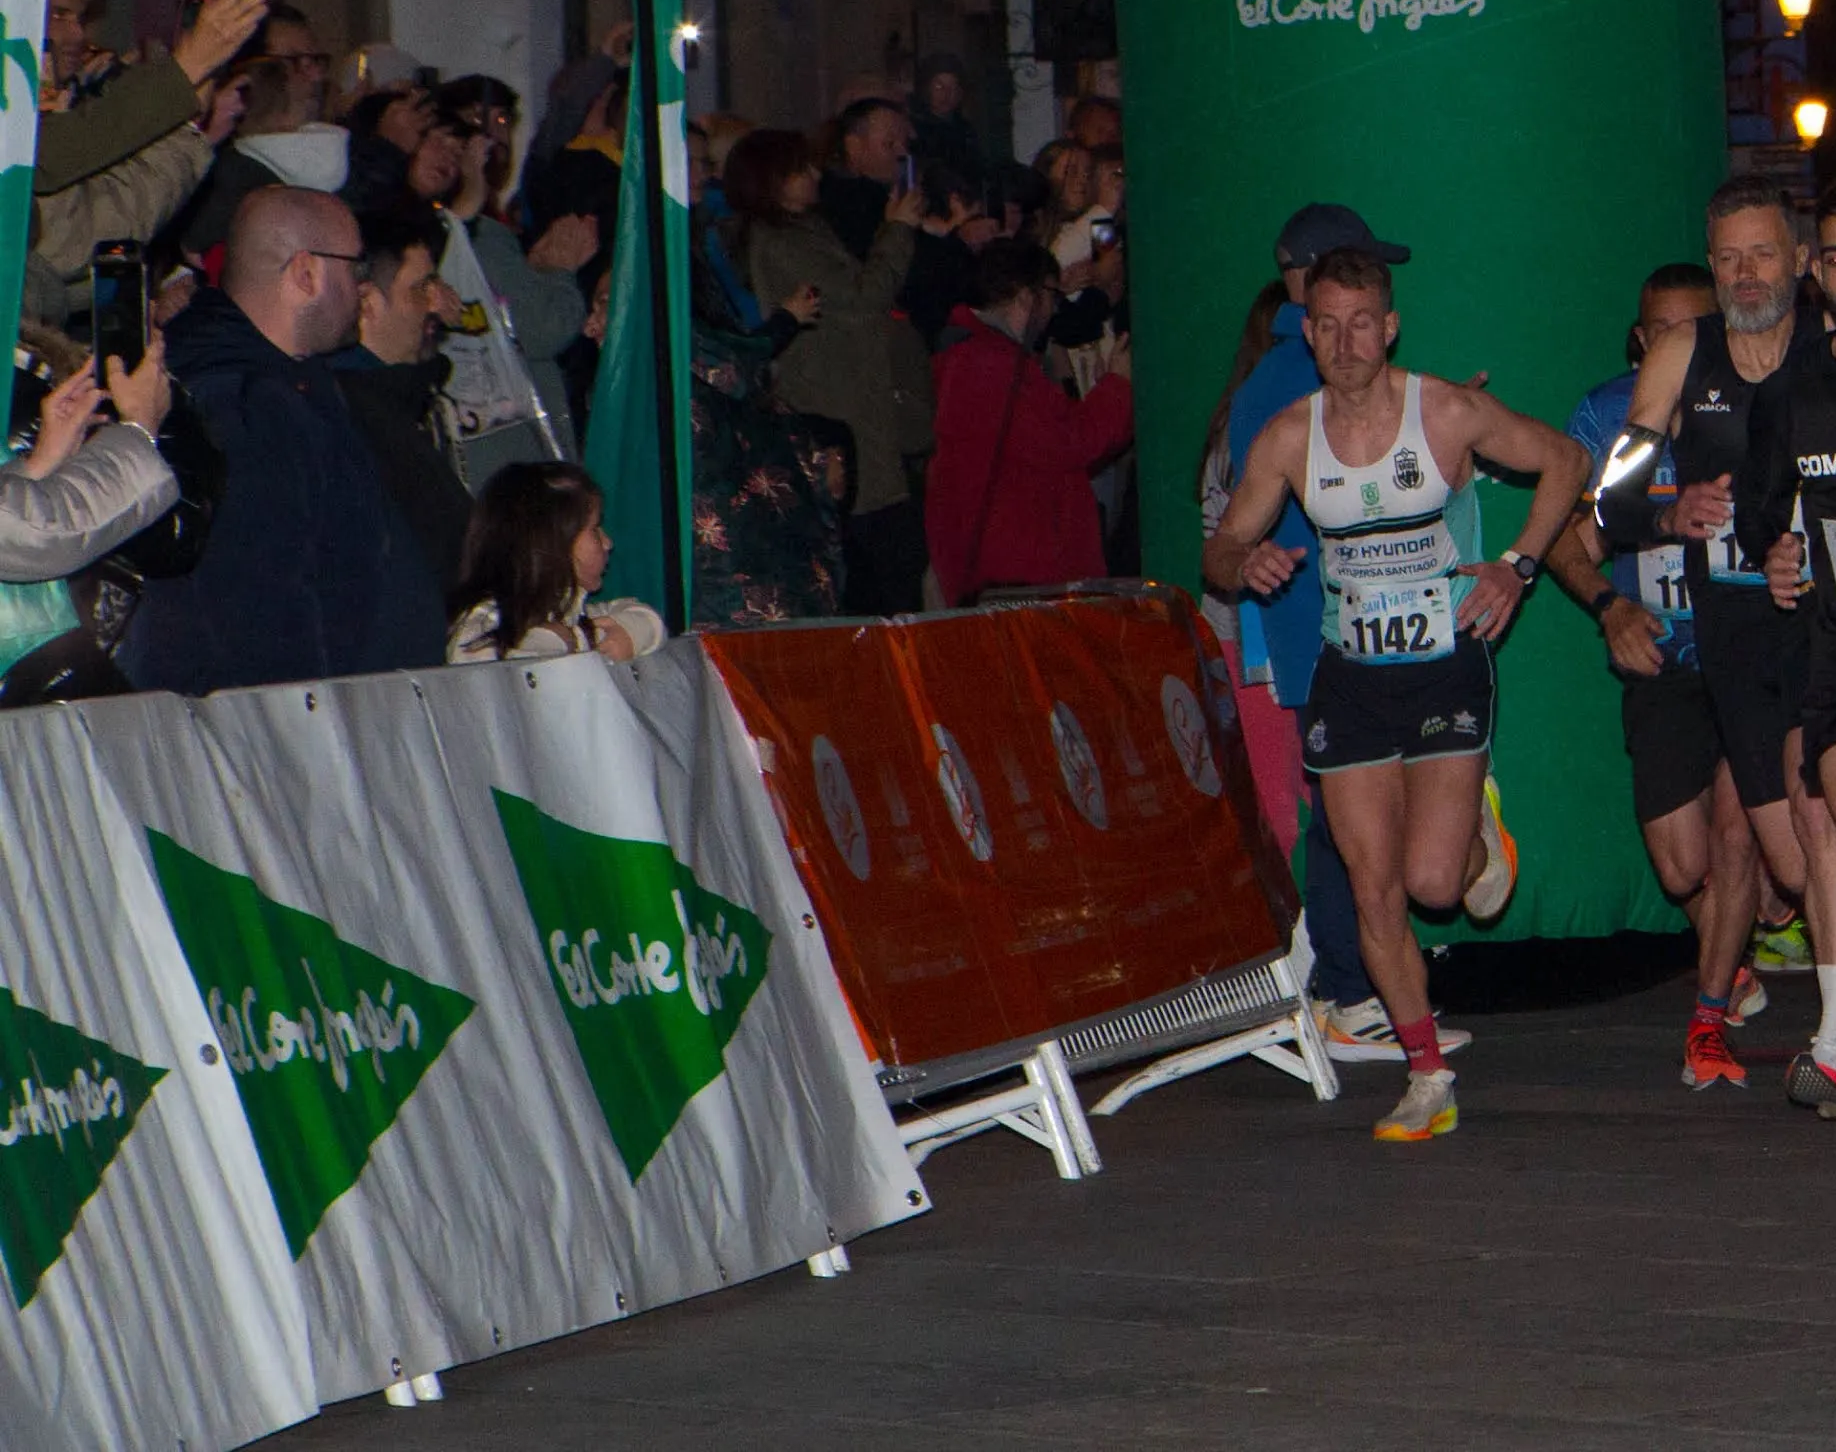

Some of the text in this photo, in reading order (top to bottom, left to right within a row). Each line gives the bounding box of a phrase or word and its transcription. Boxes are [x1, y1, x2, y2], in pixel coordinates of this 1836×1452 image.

[1360, 535, 1436, 558] HYUNDAI
[1385, 557, 1438, 576] SANTIAGO
[1350, 612, 1437, 656] 1142
